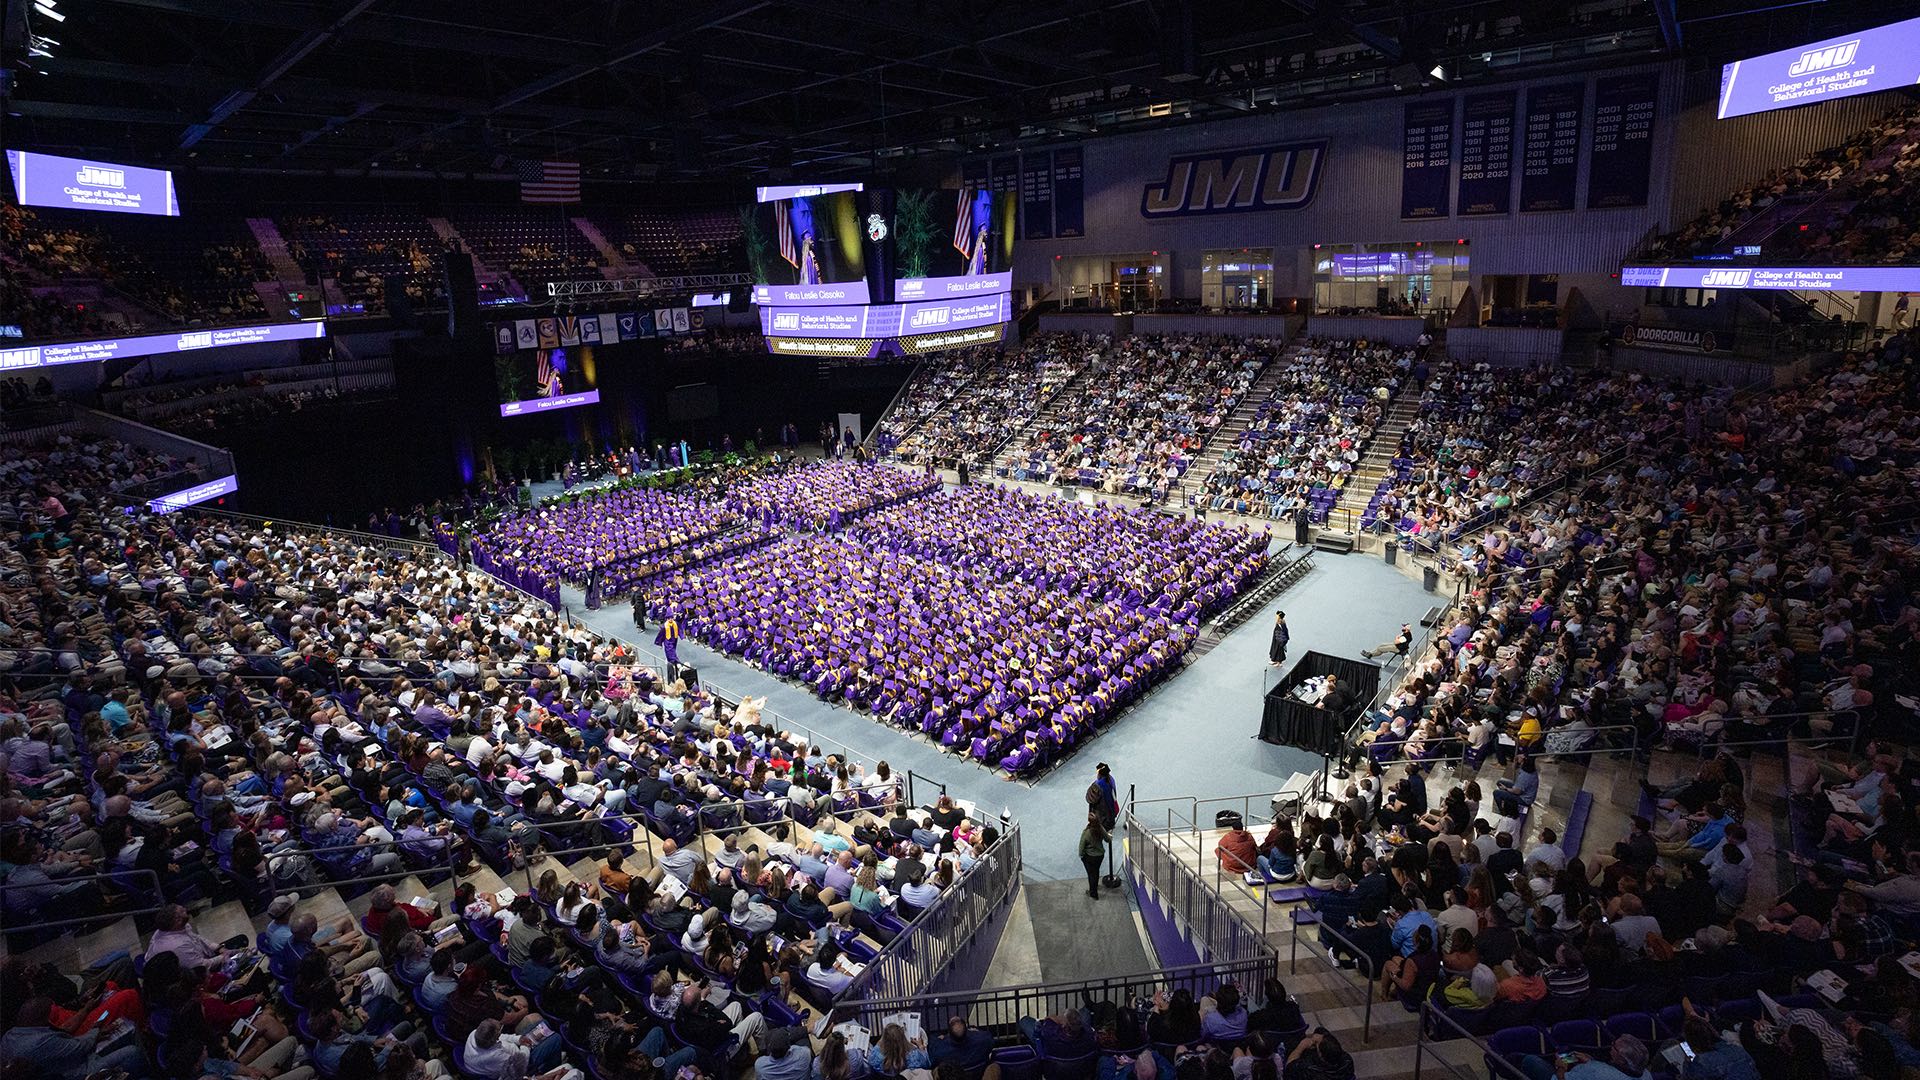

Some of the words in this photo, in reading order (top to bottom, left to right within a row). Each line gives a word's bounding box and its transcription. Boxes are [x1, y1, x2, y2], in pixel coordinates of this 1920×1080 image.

[1790, 43, 1858, 76] JMU
[1768, 82, 1802, 95] College
[1803, 78, 1815, 88] of
[1816, 70, 1851, 86] Health
[1852, 65, 1875, 79] and
[1773, 87, 1827, 103] Behavioral
[1828, 78, 1868, 93] Studies
[1597, 106, 1621, 115] 2001
[1595, 134, 1617, 143] 2017
[78, 167, 124, 188] JMU
[1486, 170, 1509, 178] 2023
[1525, 168, 1549, 176] 2023
[1145, 147, 1320, 214] JMU
[63, 186, 93, 198] College
[94, 189, 102, 198] of
[103, 190, 127, 200] Health
[128, 193, 142, 201] and
[72, 195, 113, 206] Behavioral
[114, 199, 140, 208] Studies
[1703, 270, 1750, 287] JMU
[1754, 271, 1783, 281] College
[1784, 271, 1793, 280] of
[1794, 271, 1824, 280] Health
[1824, 271, 1843, 280] and
[1753, 279, 1798, 288] Behavioral
[1799, 279, 1832, 288] Studies
[819, 290, 845, 299] Cissoko
[911, 308, 949, 327] JMU
[952, 307, 970, 317] College
[952, 312, 979, 322] Behavioral
[979, 310, 994, 319] Studies
[774, 313, 799, 330] JMU
[826, 315, 845, 323] Health
[801, 322, 829, 330] Behavioral
[178, 333, 211, 350] JMU
[1636, 327, 1700, 345] DOORGORILLA
[44, 347, 72, 356] College
[81, 343, 104, 352] Health
[104, 342, 118, 350] and
[46, 353, 86, 363] Behavioral
[86, 351, 112, 360] Studies
